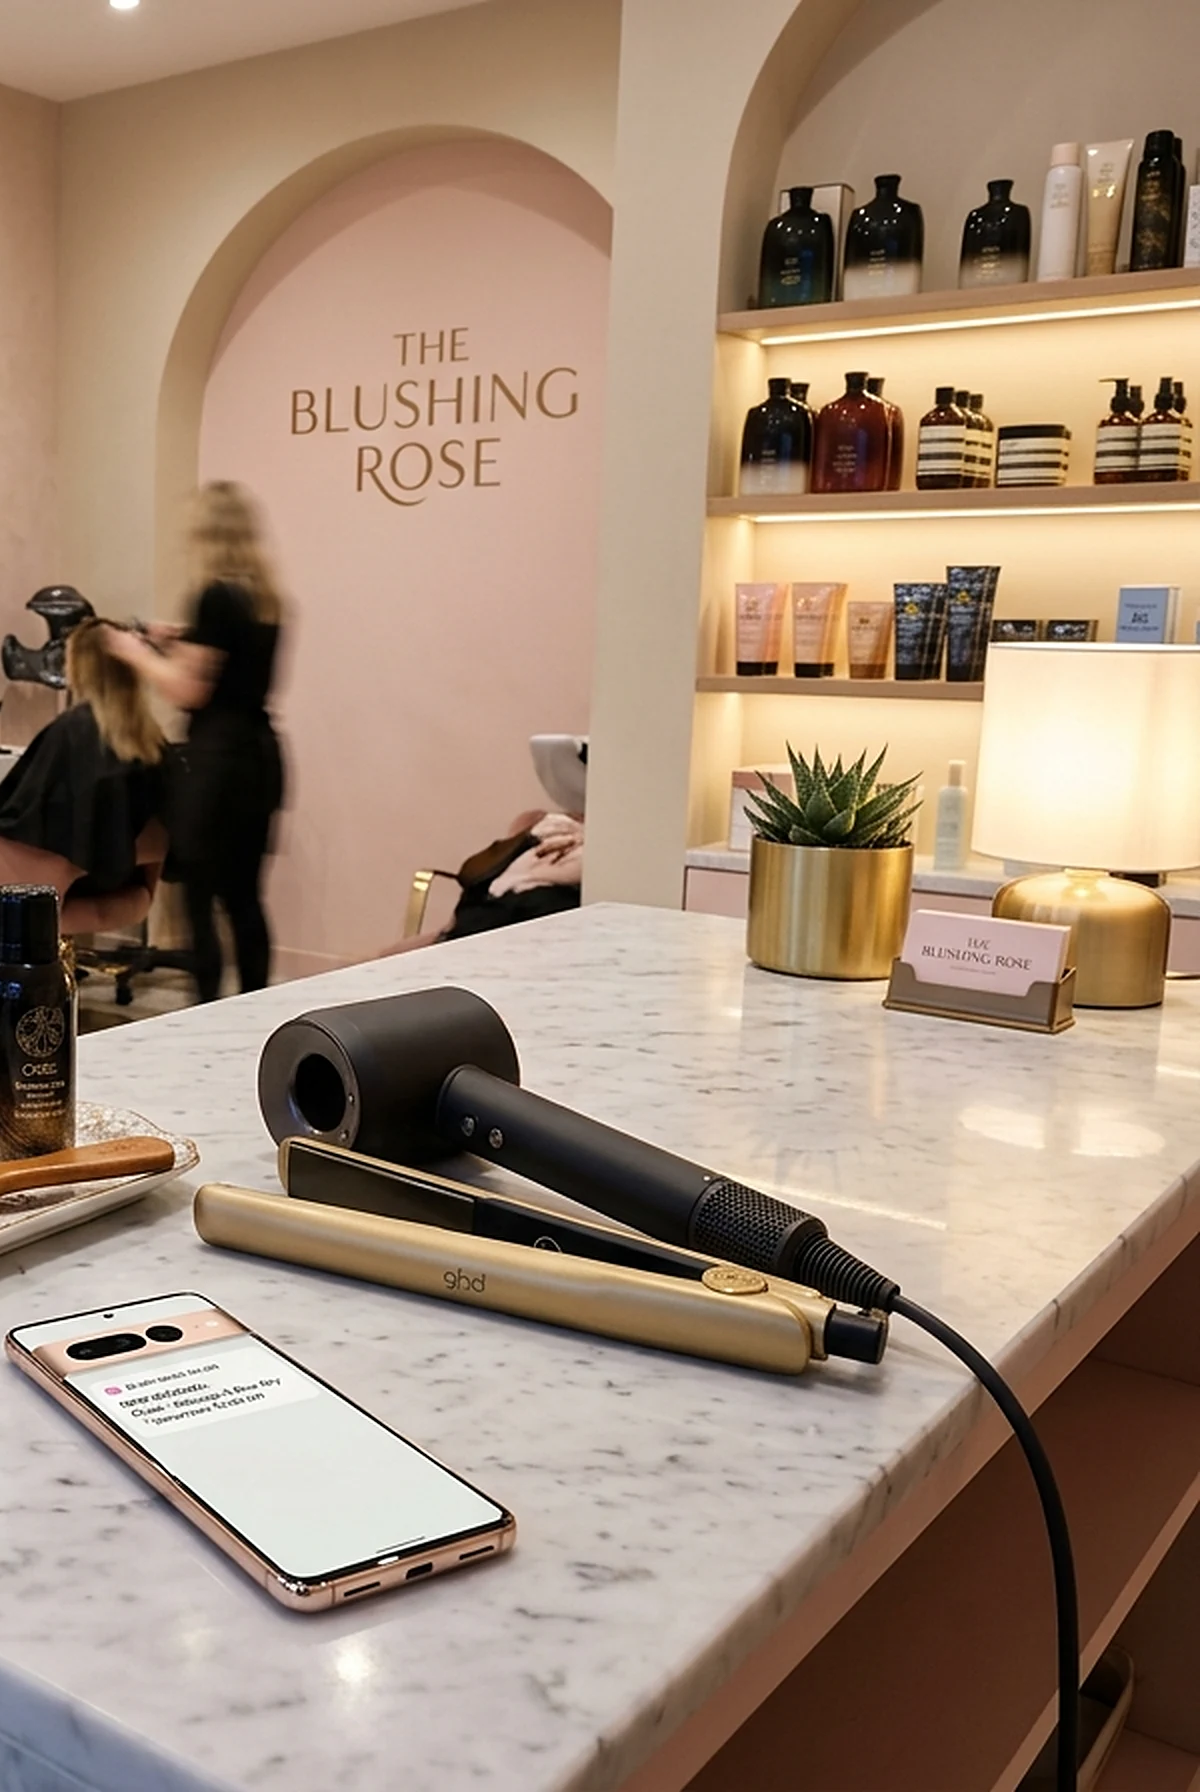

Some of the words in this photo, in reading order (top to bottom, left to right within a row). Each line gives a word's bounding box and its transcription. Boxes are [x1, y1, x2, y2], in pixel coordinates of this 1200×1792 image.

[393, 327, 470, 366] THE
[291, 367, 579, 435] BLUSHING
[356, 438, 501, 507] ROSE
[443, 1267, 486, 1293] ghd
